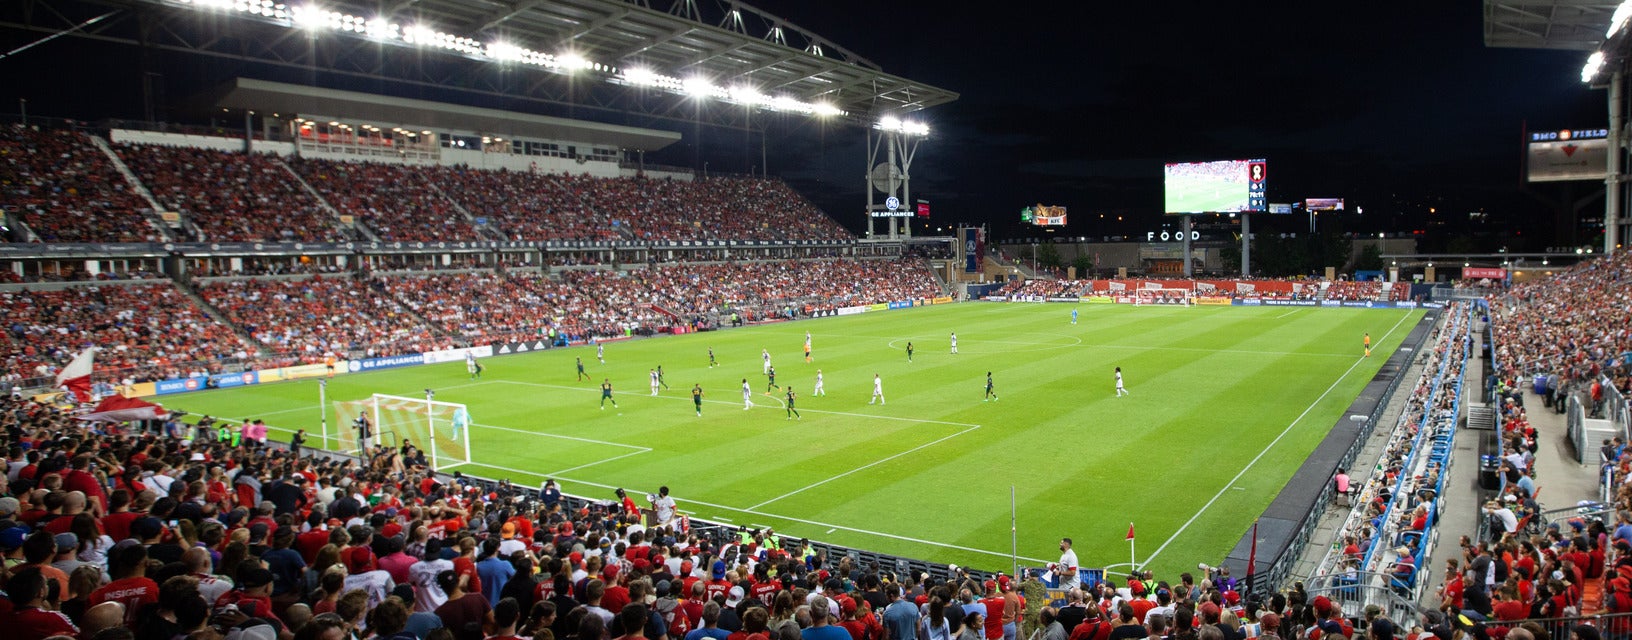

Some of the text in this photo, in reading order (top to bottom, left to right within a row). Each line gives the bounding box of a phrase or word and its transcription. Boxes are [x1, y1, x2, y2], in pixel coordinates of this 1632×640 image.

[1533, 129, 1608, 140] BMO FIELD
[363, 355, 423, 368] GE APPLIANCES
[219, 376, 241, 384] BMO
[160, 382, 183, 391] BMO
[104, 586, 147, 600] INSIGNE
